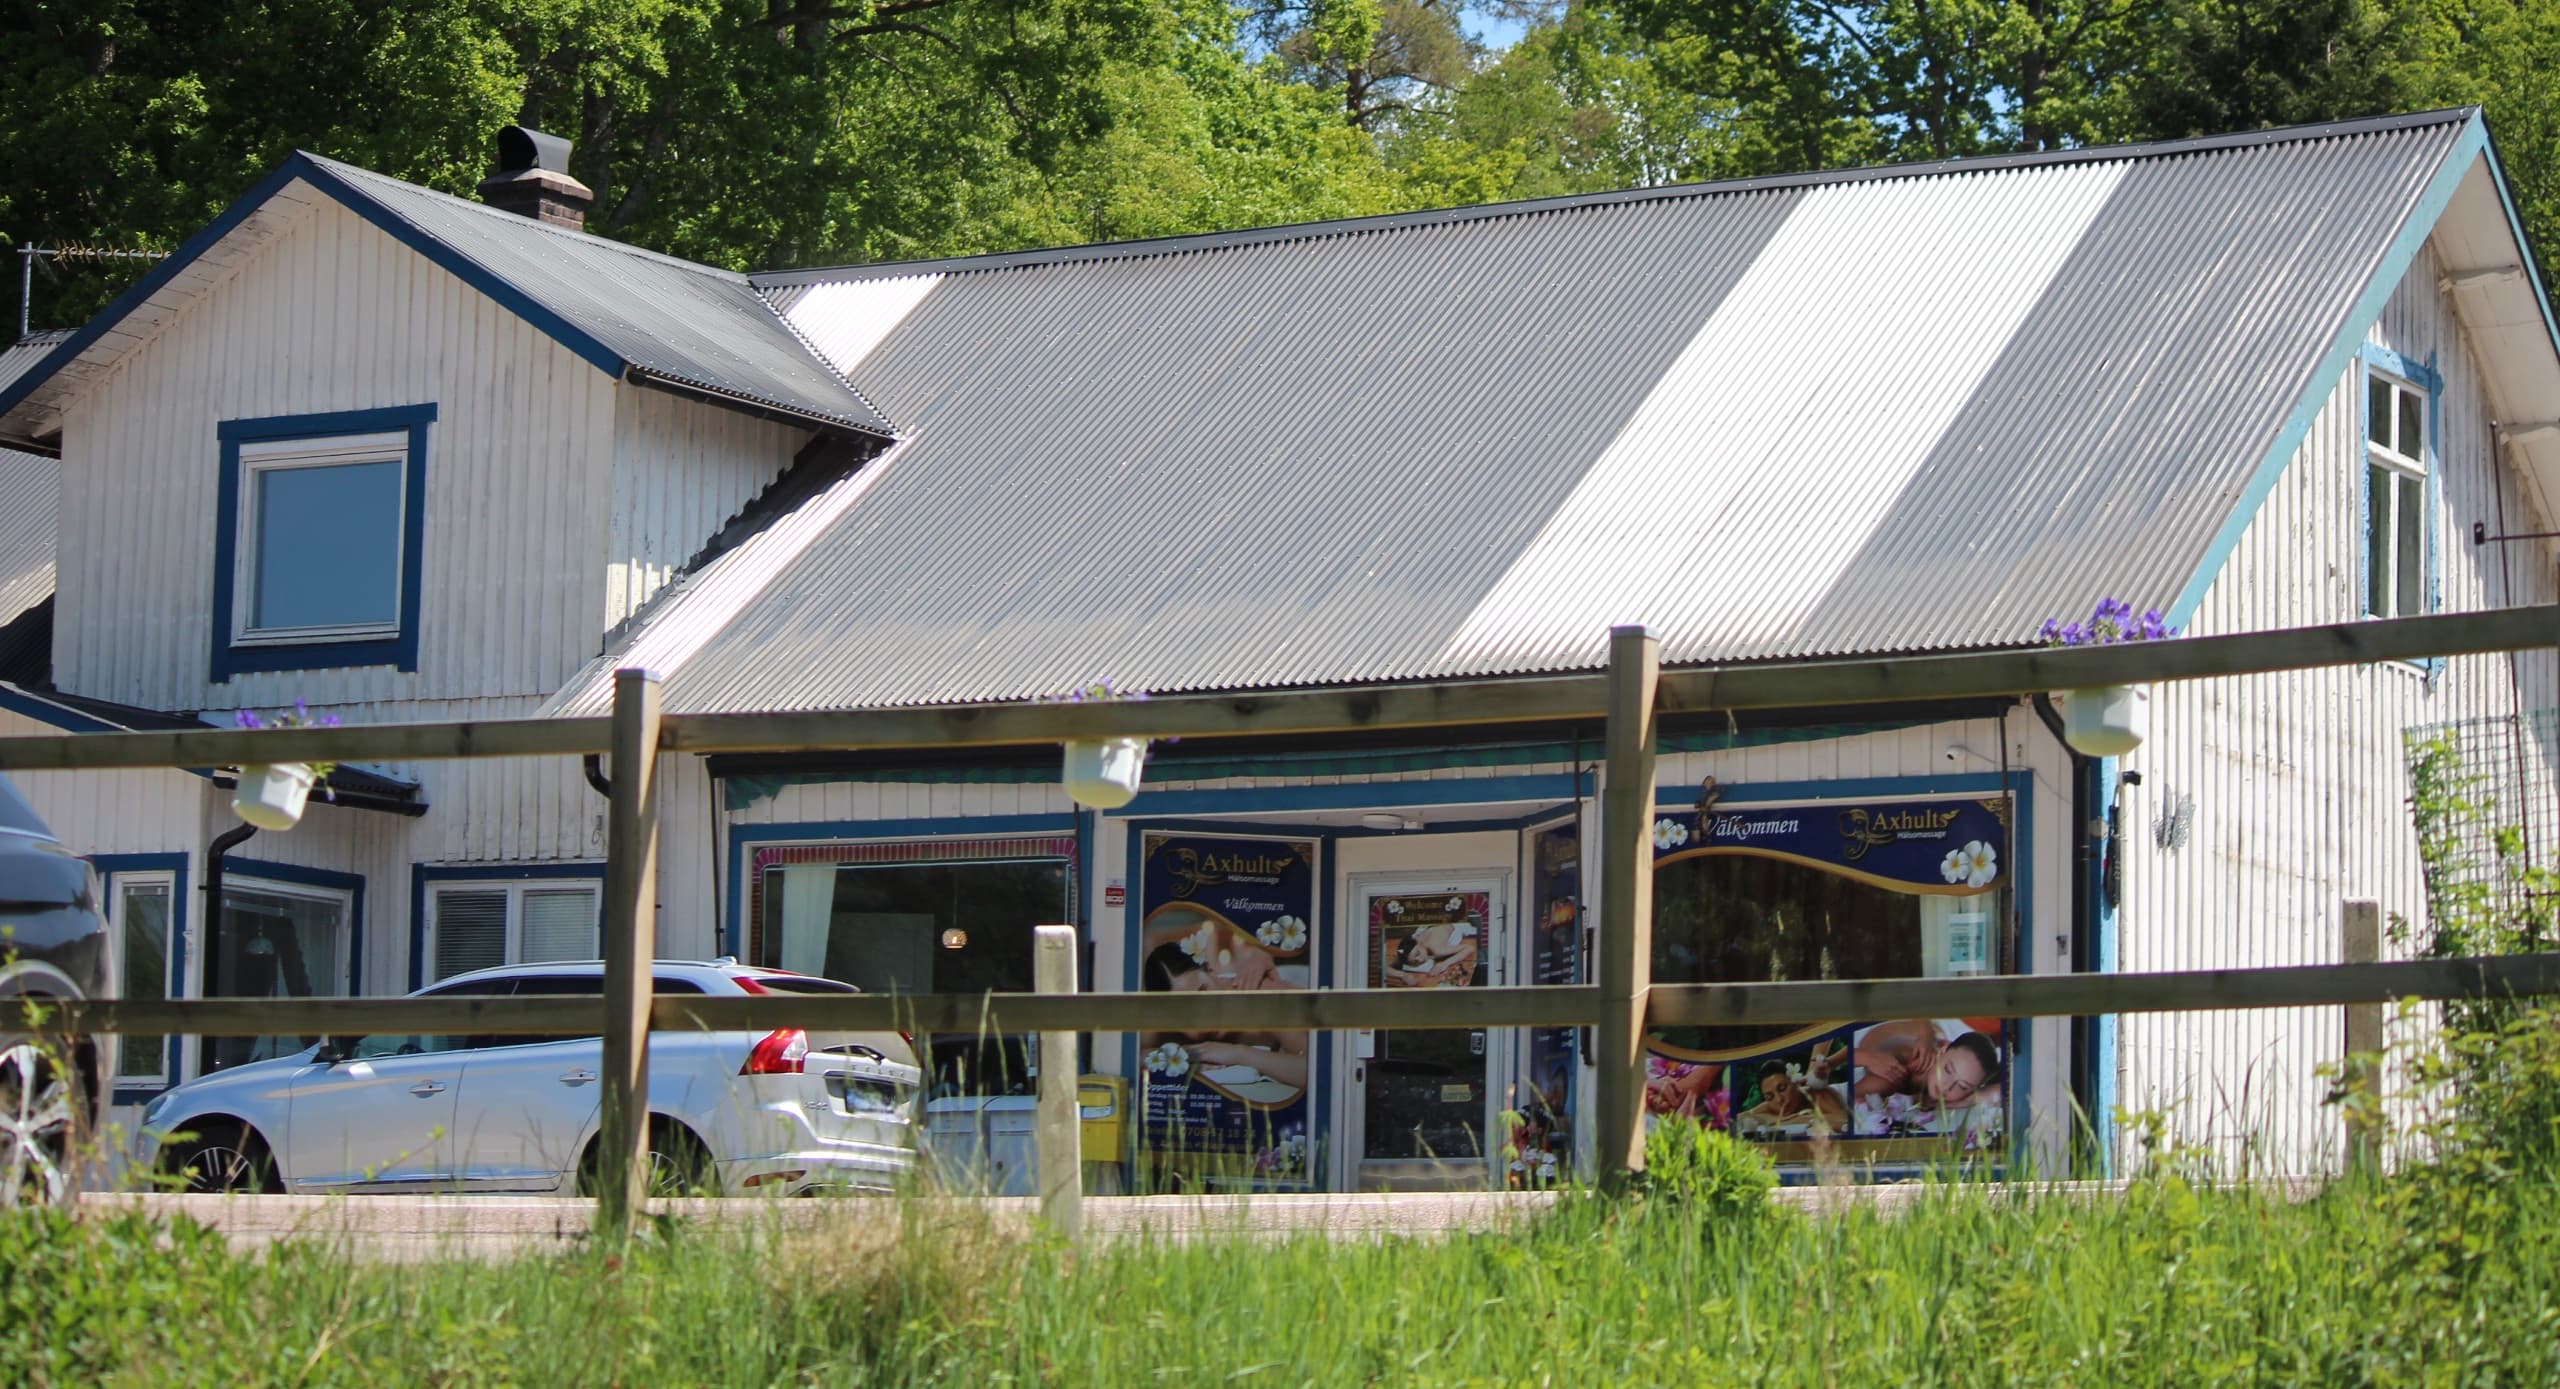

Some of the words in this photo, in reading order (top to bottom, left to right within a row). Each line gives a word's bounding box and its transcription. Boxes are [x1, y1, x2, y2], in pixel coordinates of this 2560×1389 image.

[1873, 809, 1949, 831] Axhults
[1202, 853, 1282, 874] Axhults
[1224, 897, 1284, 912] Välkommen
